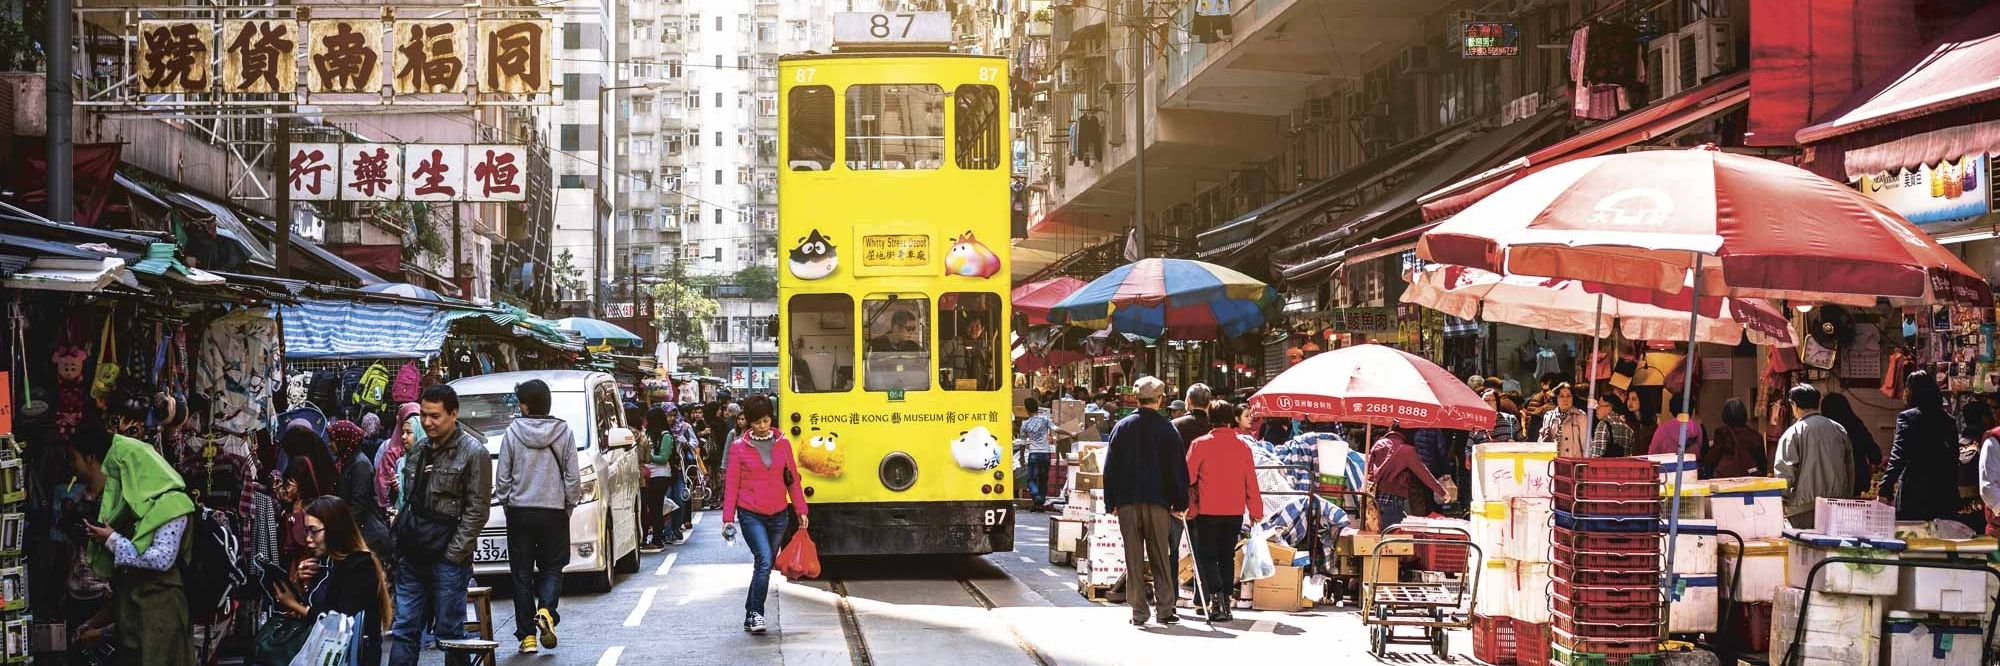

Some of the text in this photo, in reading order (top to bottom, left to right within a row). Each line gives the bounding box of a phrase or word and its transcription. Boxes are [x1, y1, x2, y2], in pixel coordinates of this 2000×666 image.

[870, 13, 915, 39] 87
[796, 67, 816, 83] 87
[979, 67, 998, 82] 87
[866, 237, 927, 250] Whitty Street Depot
[1366, 402, 1428, 418] 2681 8888
[809, 413, 820, 425] 香
[849, 412, 860, 425] 港
[862, 414, 889, 423] KONG
[890, 412, 901, 424] 藝
[903, 413, 944, 422] MUSEUM
[946, 411, 956, 423] 術
[957, 413, 970, 421] OF
[971, 412, 988, 421] ART
[988, 411, 999, 423] 館
[985, 508, 1007, 525] 87
[482, 539, 500, 550] SL
[474, 549, 508, 561] 3394
